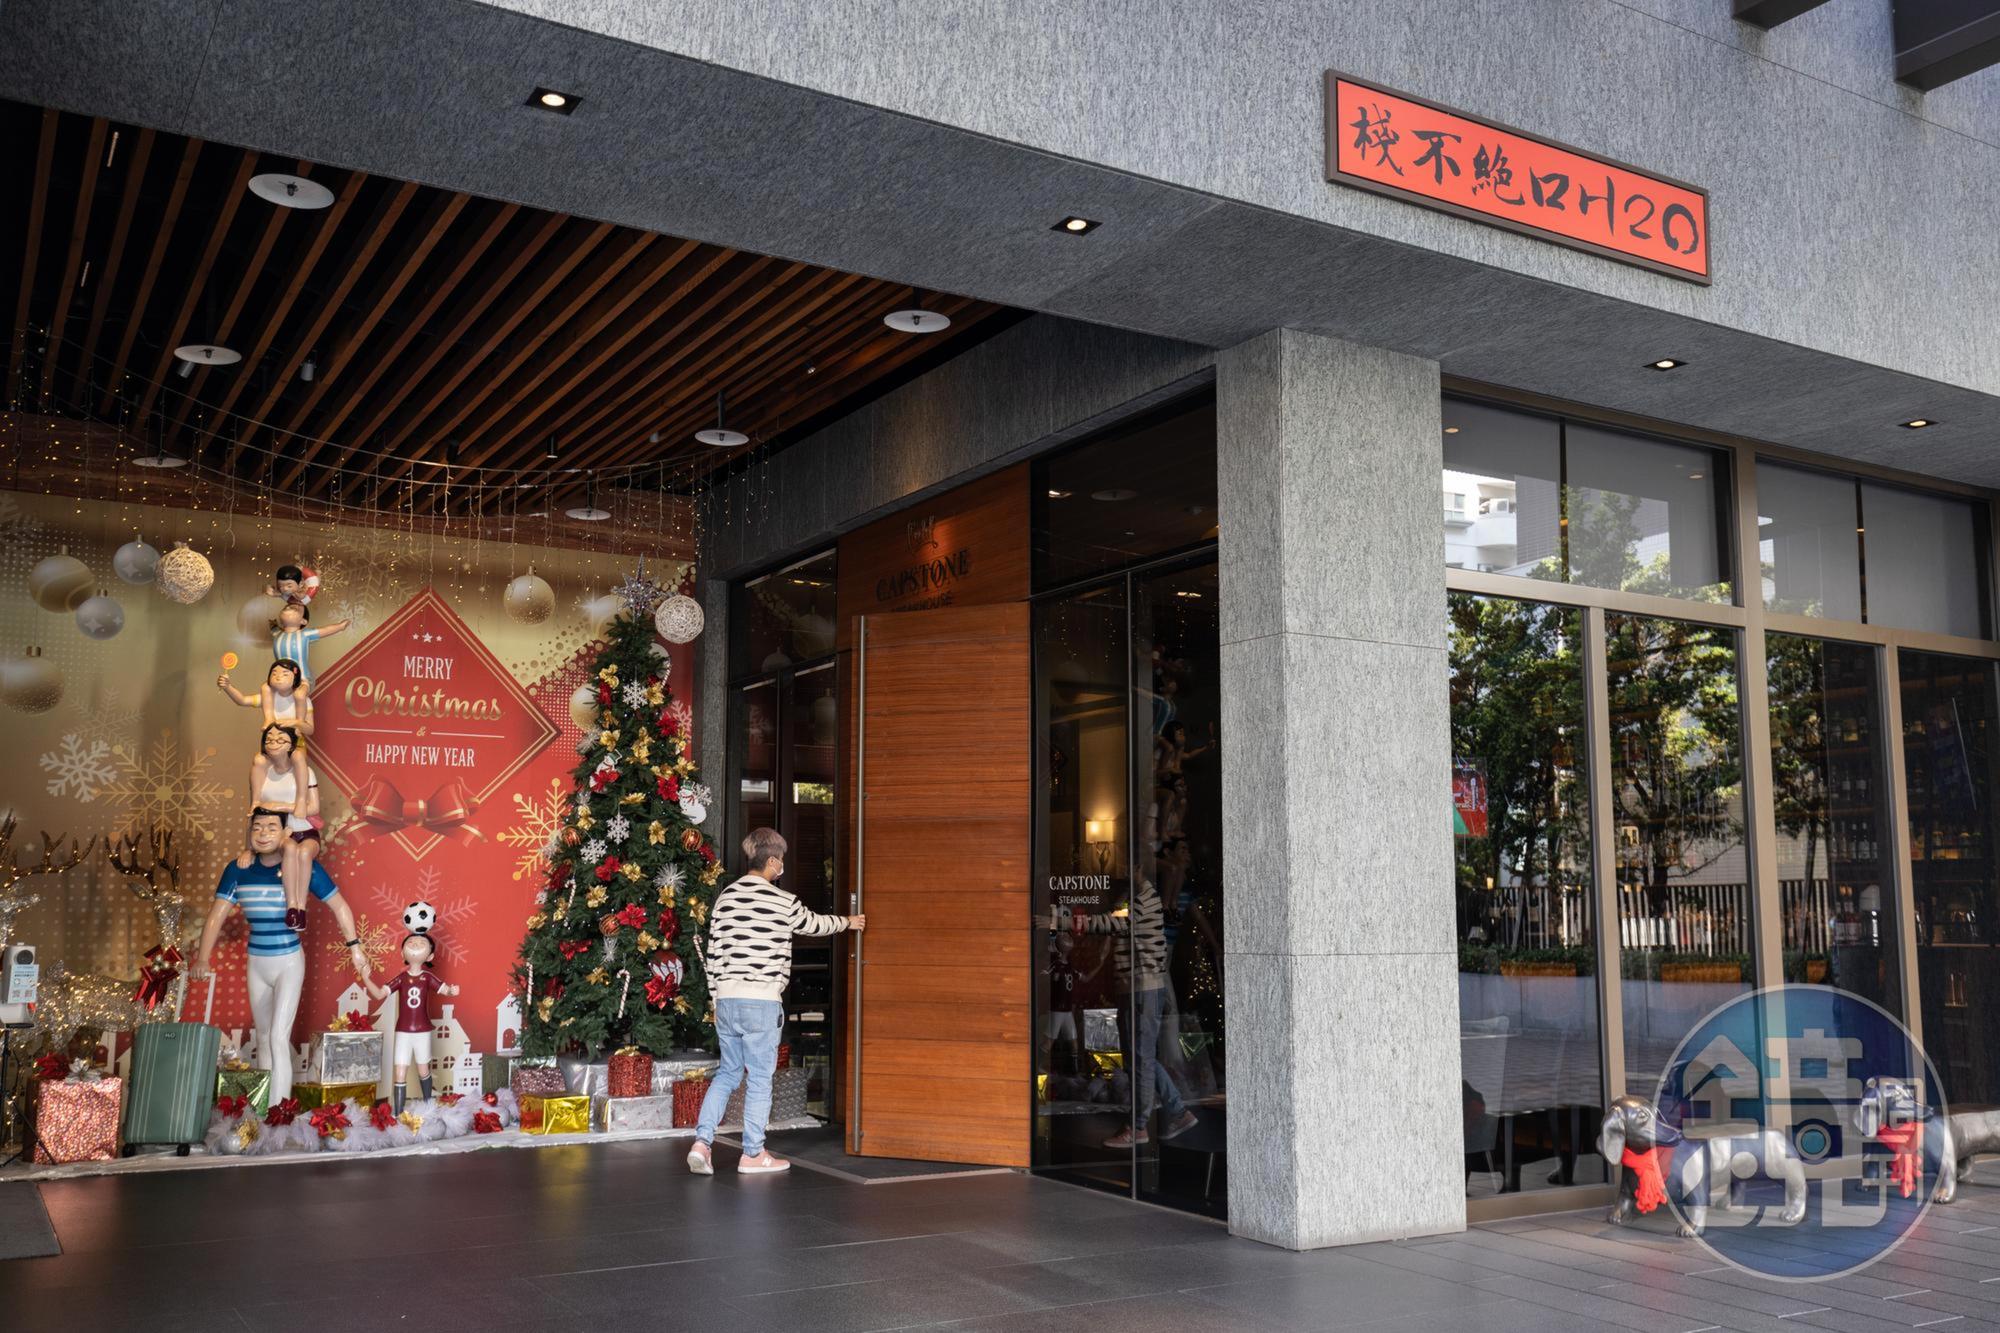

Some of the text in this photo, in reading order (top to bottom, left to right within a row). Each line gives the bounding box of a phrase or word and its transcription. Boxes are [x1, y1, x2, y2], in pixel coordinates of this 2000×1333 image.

[876, 549, 970, 601] CAPSTONE
[403, 656, 453, 680] MERRY
[345, 676, 505, 720] Christmas
[416, 726, 427, 737] &
[366, 743, 475, 767] HAPPY NEW YEAR
[1049, 875, 1111, 890] CAPSTONE
[1058, 895, 1100, 905] STEAKHOUSE
[407, 986, 421, 1009] 8
